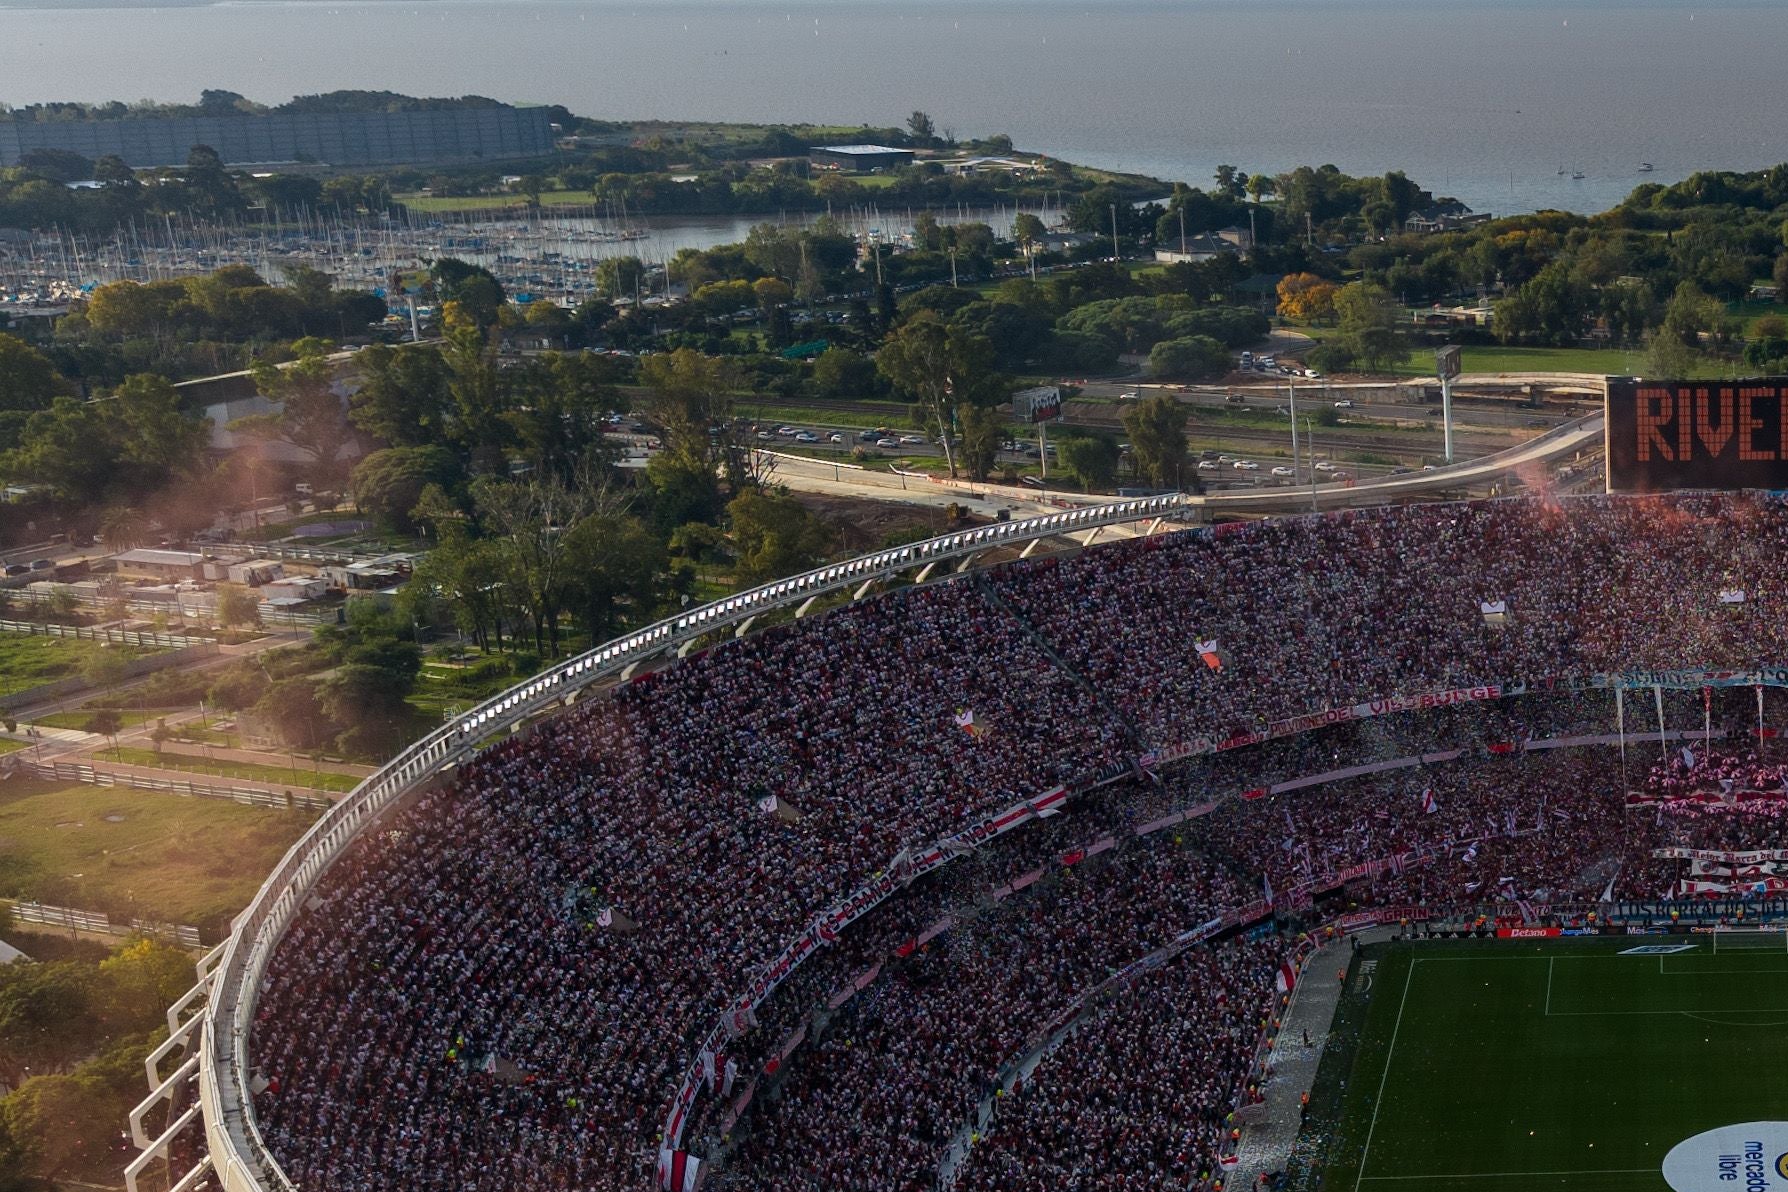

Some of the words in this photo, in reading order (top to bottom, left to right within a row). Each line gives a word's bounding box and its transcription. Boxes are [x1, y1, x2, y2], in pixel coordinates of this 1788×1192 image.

[935, 817, 1000, 862] MNDO
[1511, 928, 1547, 938] Betano
[1718, 1154, 1742, 1181] libre
